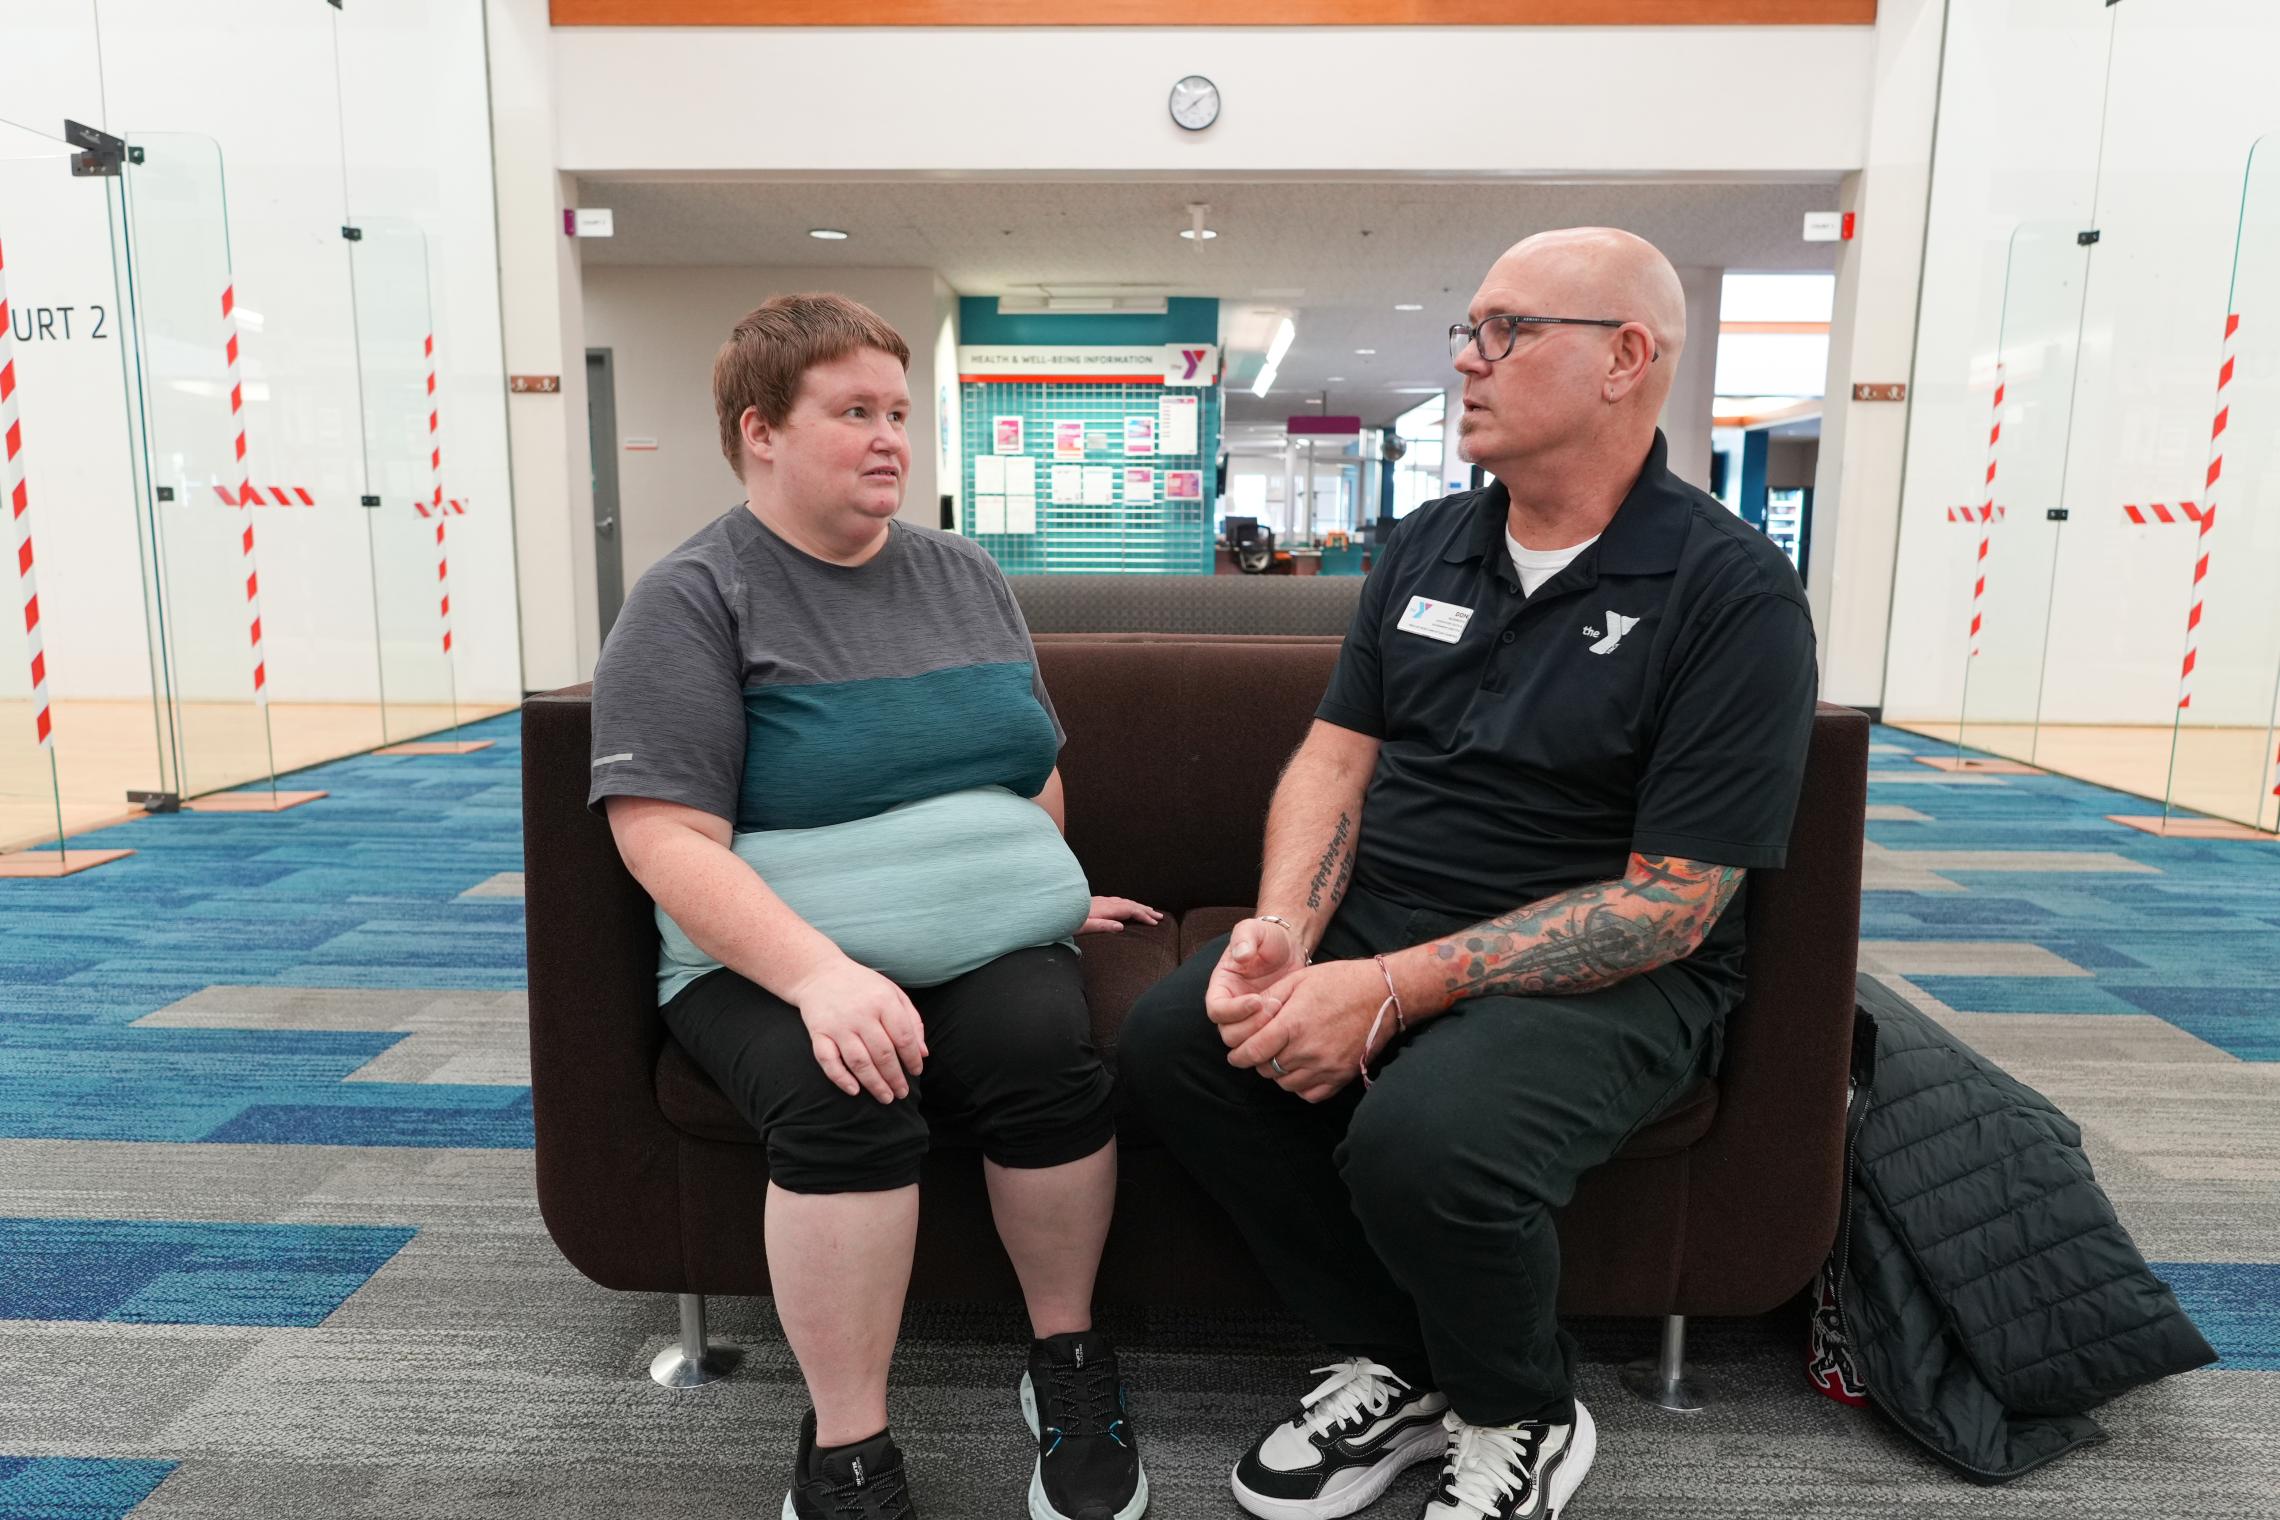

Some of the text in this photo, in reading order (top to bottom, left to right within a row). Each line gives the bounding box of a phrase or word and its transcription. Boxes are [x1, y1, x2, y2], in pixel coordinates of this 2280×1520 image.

[10, 305, 108, 342] URT 2
[970, 354, 1153, 365] HEALTH & WELL-BEING INFORMATION
[1582, 625, 1601, 638] the
